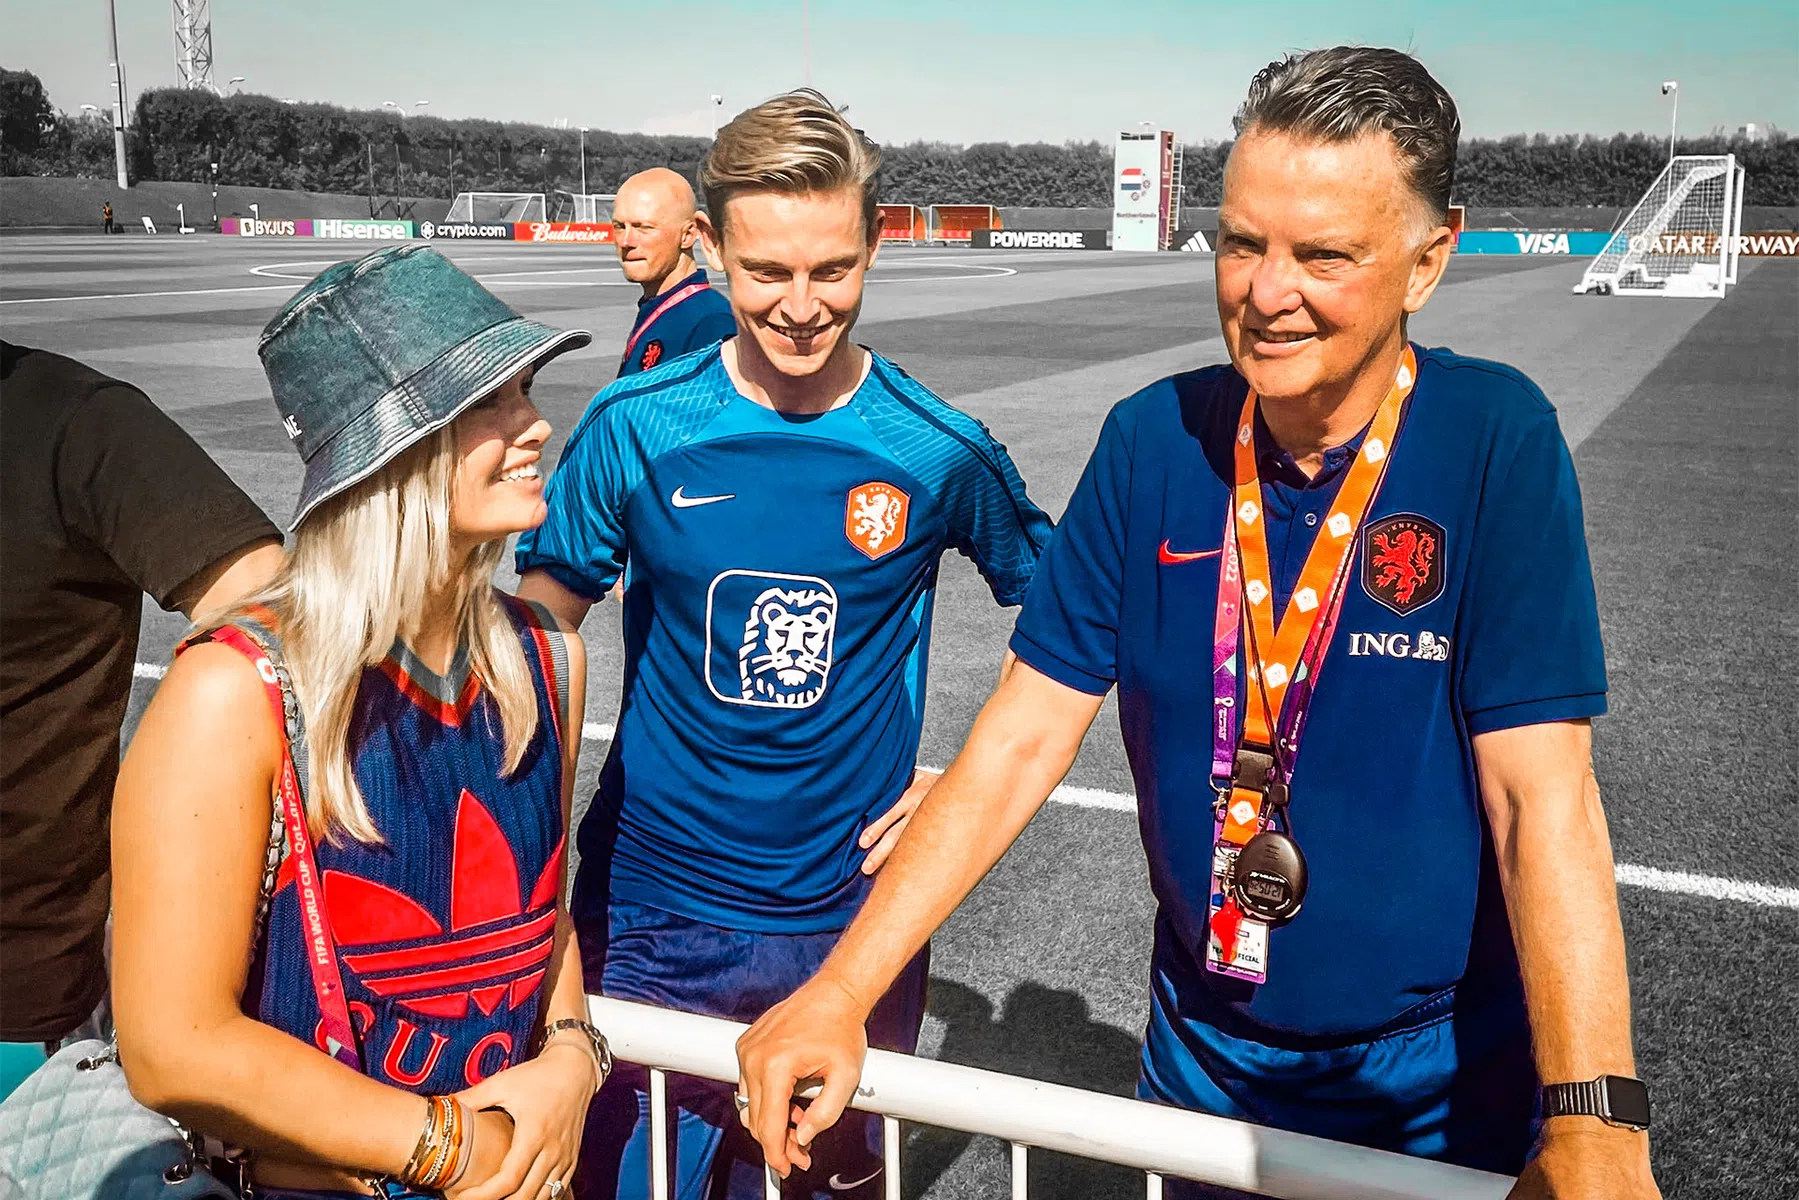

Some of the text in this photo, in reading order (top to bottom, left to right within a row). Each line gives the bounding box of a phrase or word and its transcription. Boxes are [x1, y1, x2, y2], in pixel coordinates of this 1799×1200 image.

[255, 220, 295, 236] BYJU'S
[319, 219, 407, 239] Hisense
[437, 224, 507, 238] crypto.com
[530, 223, 608, 241] Budweiser
[990, 231, 1083, 248] POWERADE
[1514, 233, 1570, 254] VISA
[1629, 235, 1706, 254] QATAR
[1349, 632, 1411, 658] ING
[299, 860, 312, 886] CUP
[304, 888, 323, 936] WORLD
[314, 936, 329, 965] FIFA
